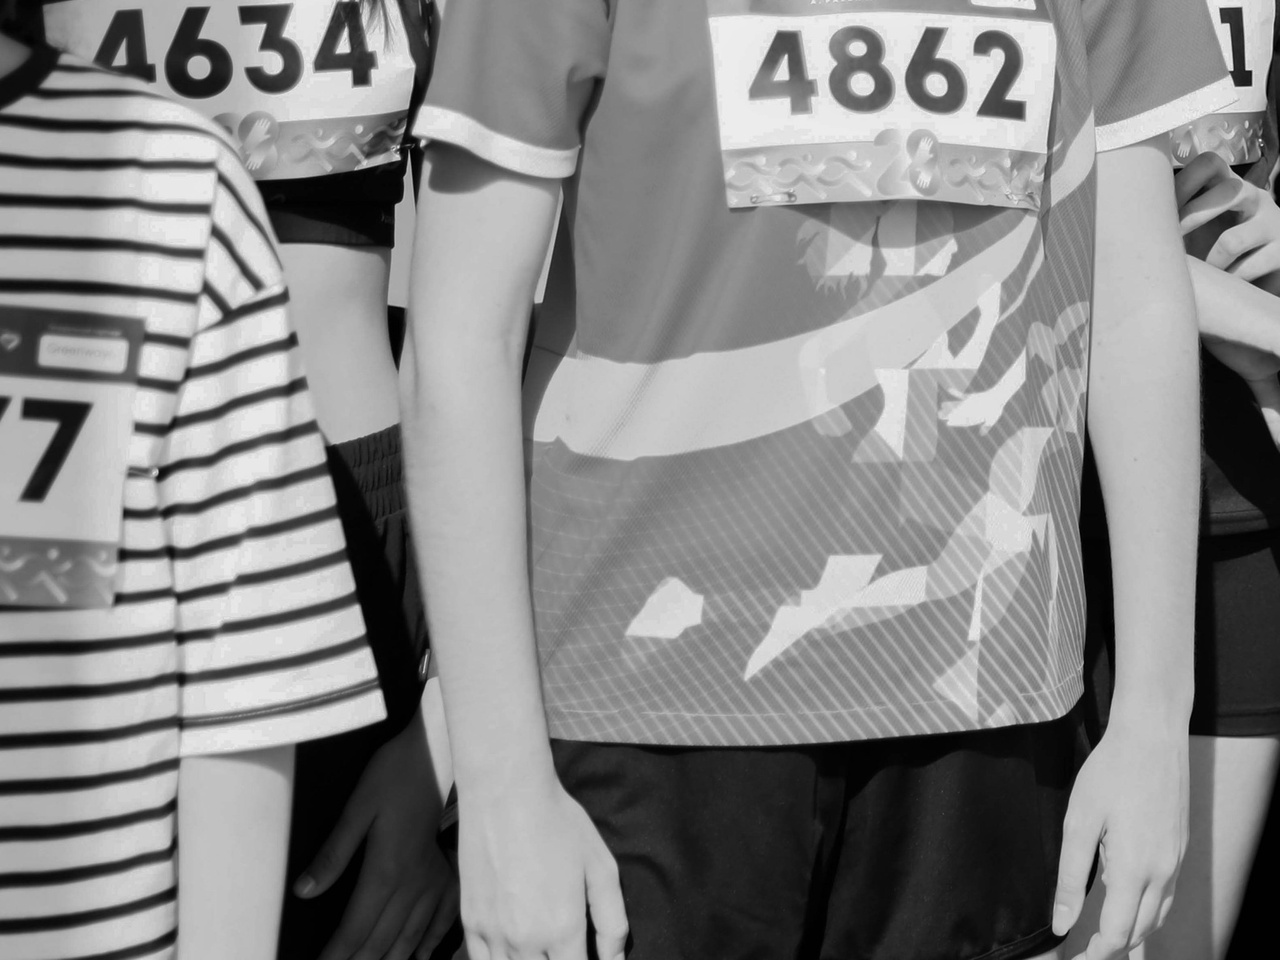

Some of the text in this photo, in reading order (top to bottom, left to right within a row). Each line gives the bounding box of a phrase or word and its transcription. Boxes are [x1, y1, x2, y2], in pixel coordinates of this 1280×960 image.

[92, 1, 378, 99] 4634
[748, 25, 1027, 122] 4862
[1219, 7, 1253, 87] 1
